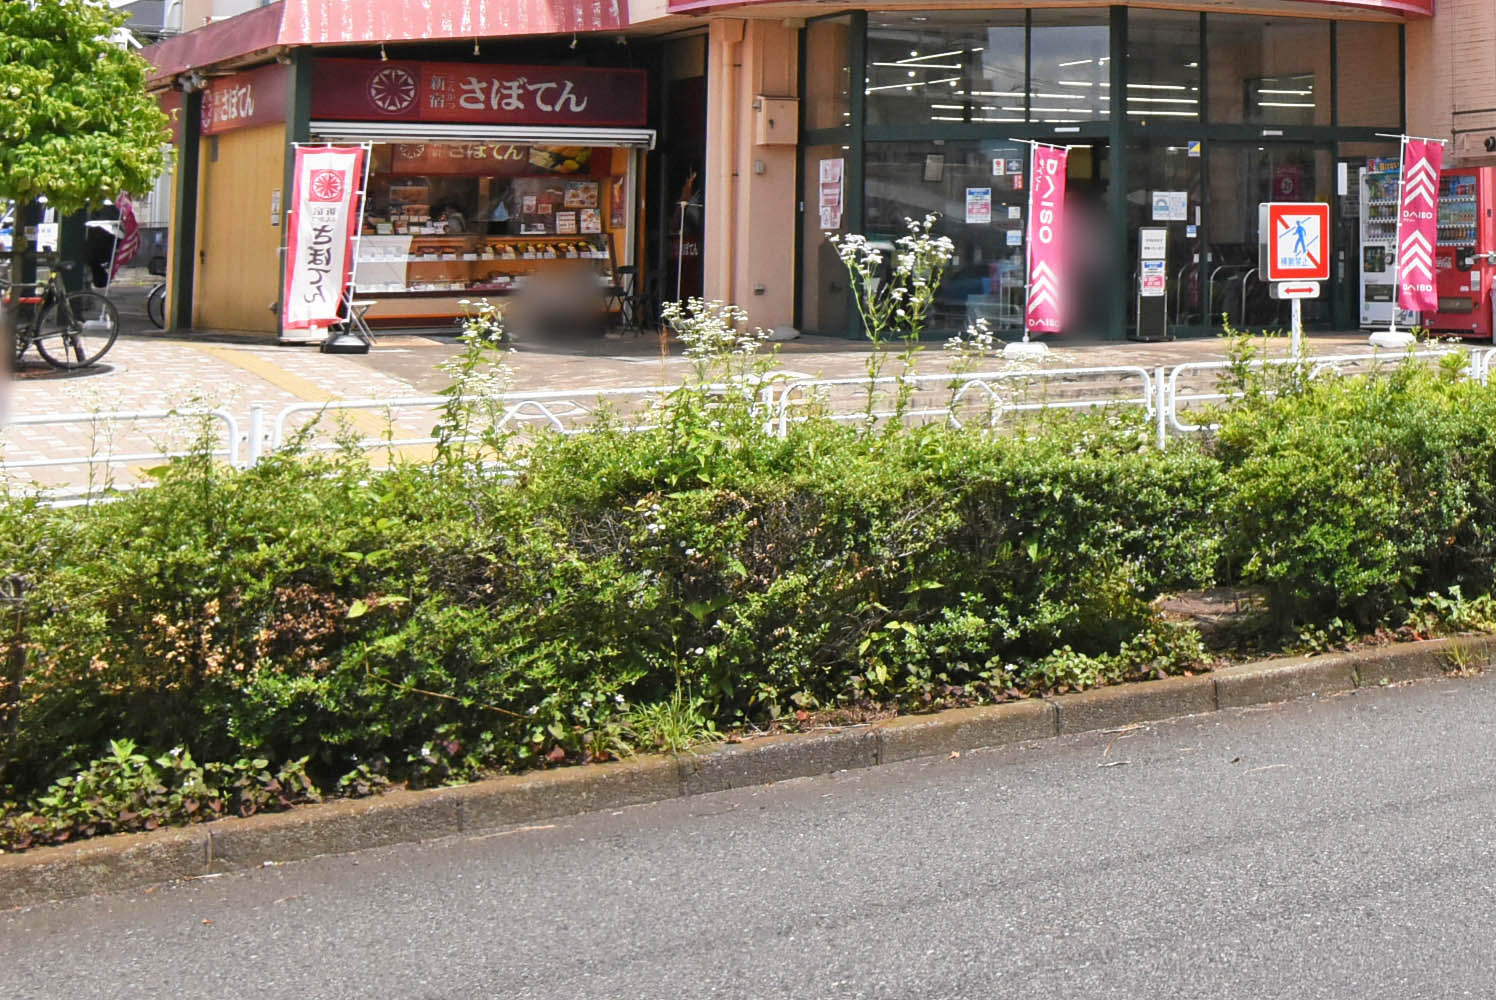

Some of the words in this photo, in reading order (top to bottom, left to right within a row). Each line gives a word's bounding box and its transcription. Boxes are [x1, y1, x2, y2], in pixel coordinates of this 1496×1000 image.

[458, 76, 588, 113] さぼてん
[1039, 158, 1059, 245] DAISO
